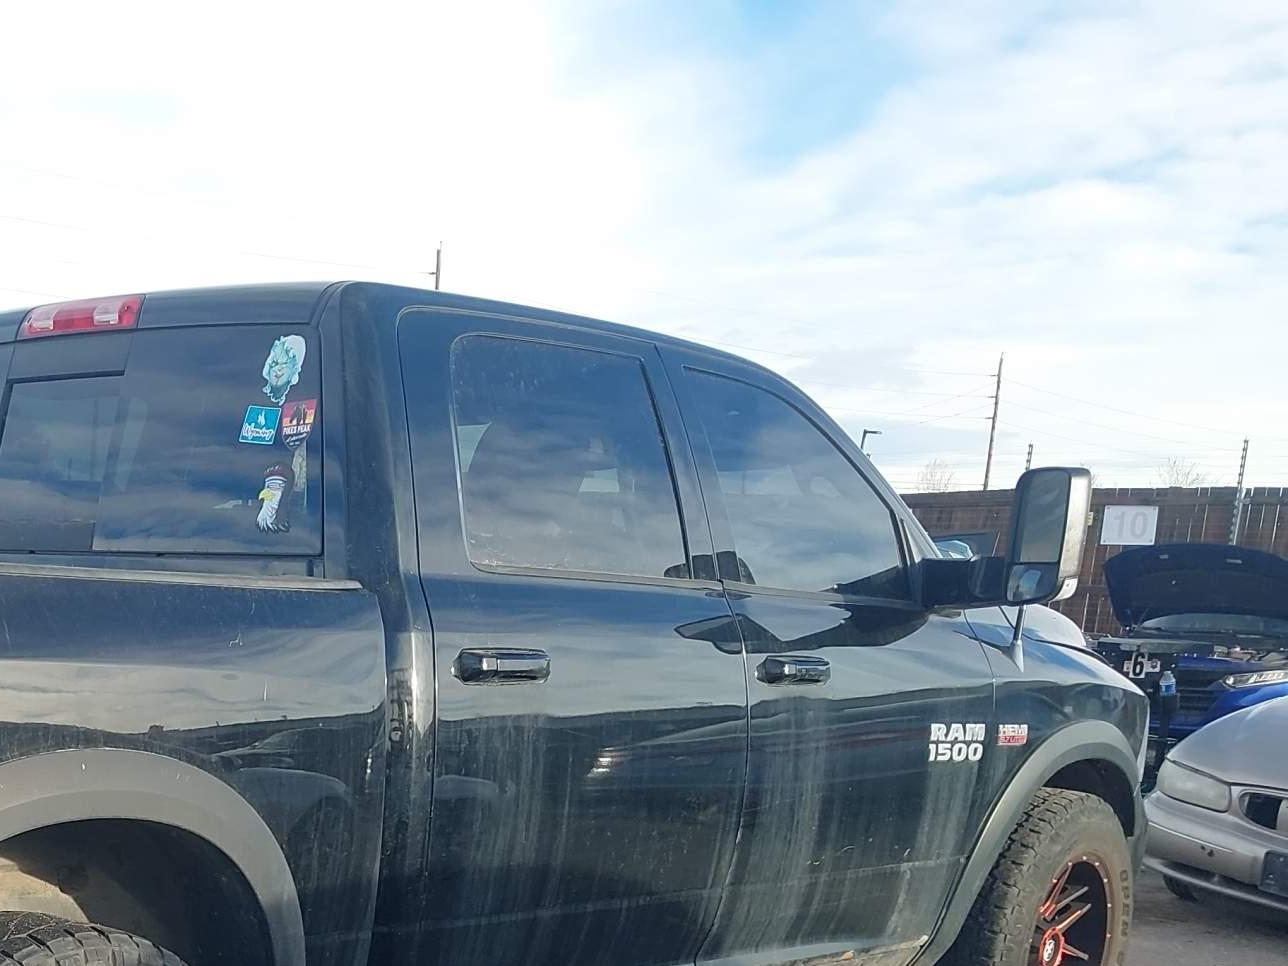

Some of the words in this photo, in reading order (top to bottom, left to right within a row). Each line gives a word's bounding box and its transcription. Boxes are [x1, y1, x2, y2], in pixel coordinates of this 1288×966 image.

[1113, 511, 1148, 540] 10
[1132, 652, 1146, 677] 6
[930, 723, 986, 741] RAM
[928, 742, 983, 762] 1500
